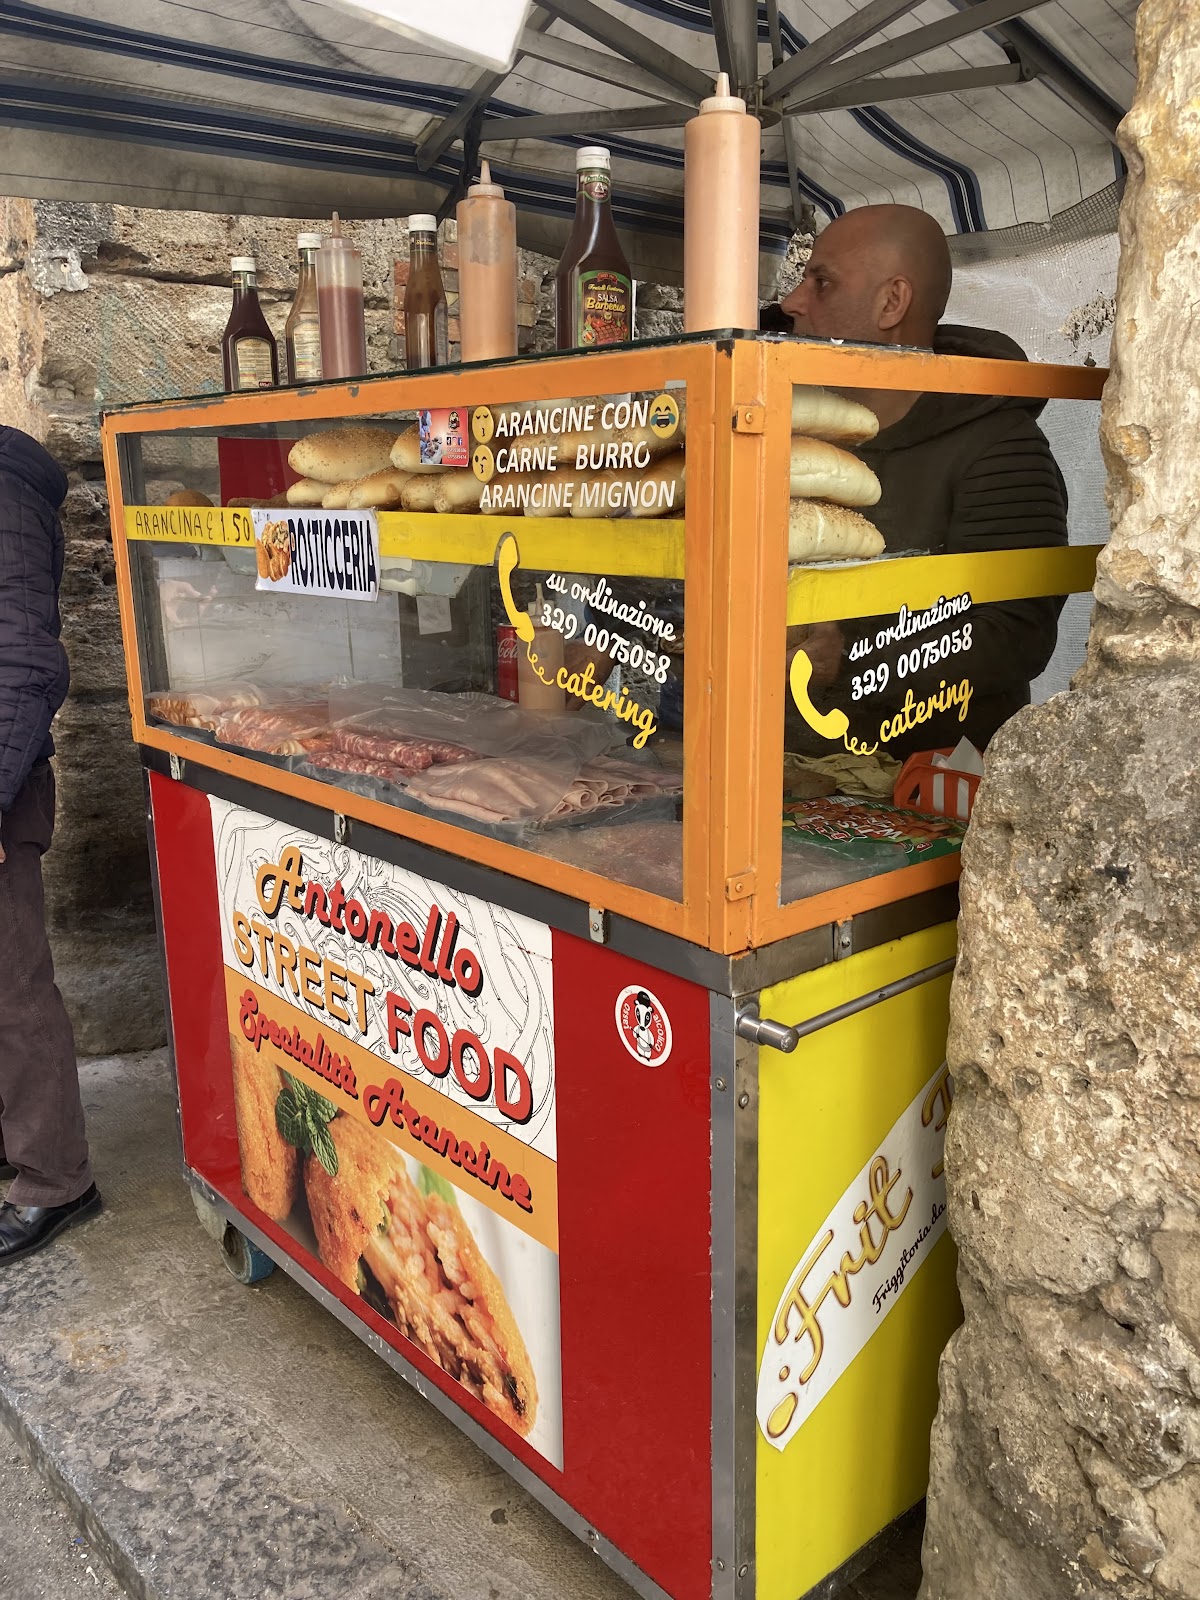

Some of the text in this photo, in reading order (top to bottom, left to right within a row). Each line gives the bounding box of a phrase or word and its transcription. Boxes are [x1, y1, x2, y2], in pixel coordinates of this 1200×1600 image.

[586, 297, 627, 313] Barbecue
[597, 293, 618, 303] SALSA
[495, 400, 649, 438] ARANCINE CON
[496, 441, 650, 473] CARNE BURRO
[135, 507, 202, 538] ARANCINA
[220, 512, 250, 542] 1.50
[480, 480, 676, 509] ARANCINE MIGNON
[288, 517, 377, 593] ROSTICCERIA
[546, 572, 676, 642] su ordinazione
[848, 592, 972, 662] su ordinazione
[541, 603, 671, 684] 329 0075058
[851, 623, 973, 701] 329 0075058
[556, 661, 657, 750] catering
[879, 678, 974, 743] catering
[255, 846, 484, 998] Antonello
[232, 911, 534, 1126] STREET FOOD
[652, 1013, 665, 1052] alcolico
[239, 988, 534, 1214] Specialità Arancine
[775, 1155, 915, 1386] Frit
[872, 1226, 932, 1315] Friggitoria
